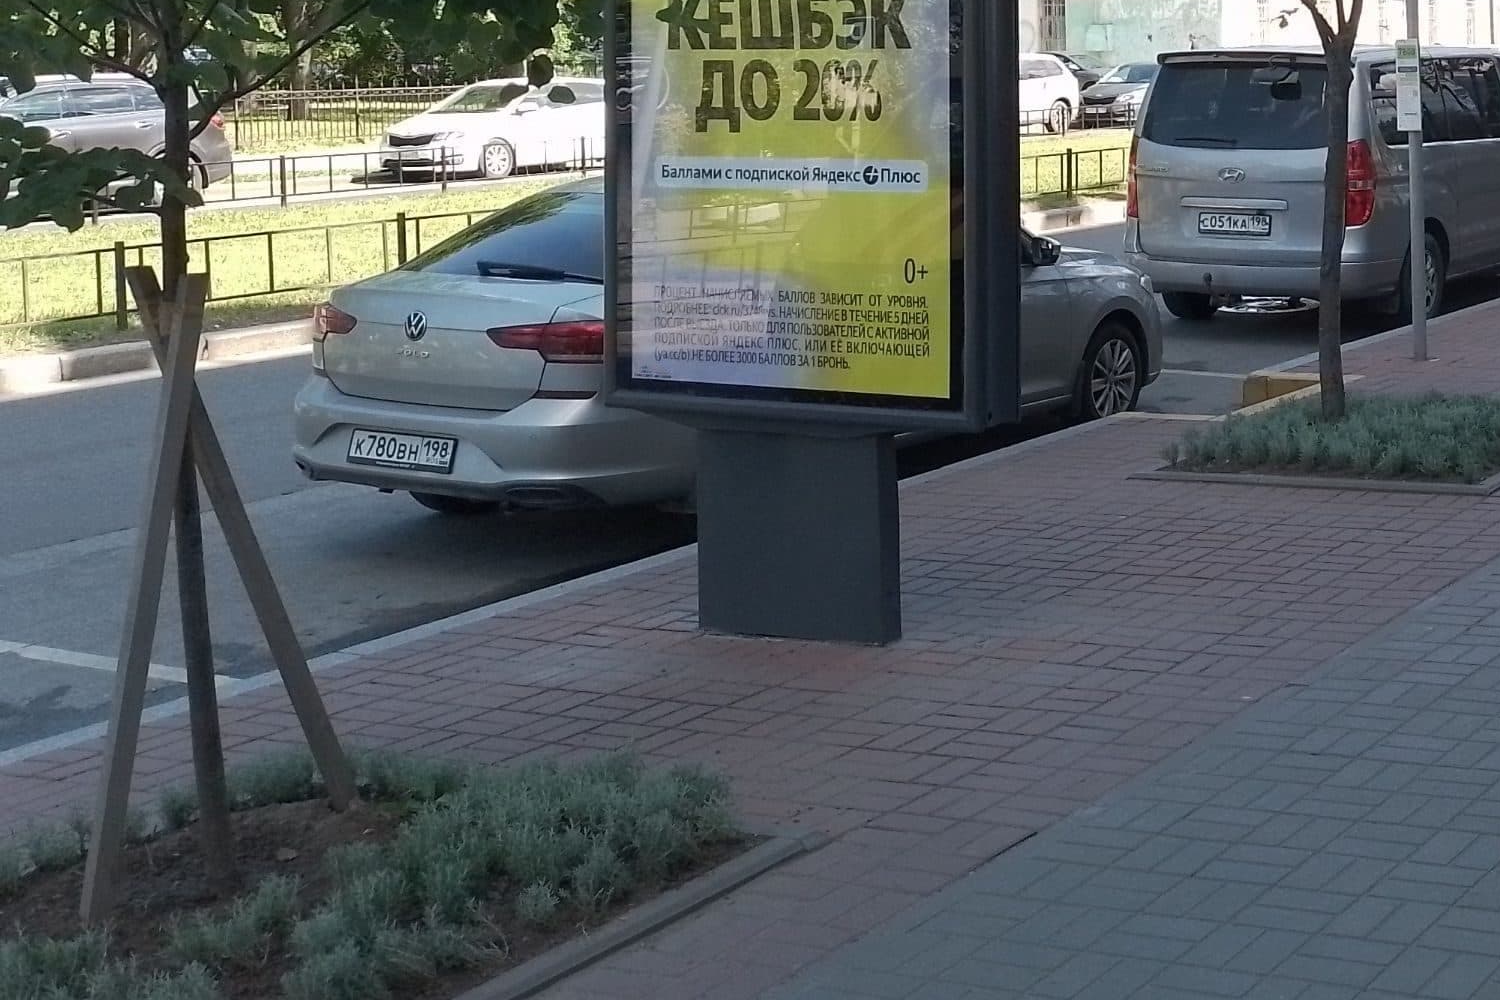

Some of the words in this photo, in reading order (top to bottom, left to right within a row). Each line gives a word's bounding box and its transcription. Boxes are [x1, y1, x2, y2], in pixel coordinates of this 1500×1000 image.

[695, 59, 781, 133] ДО
[661, 164, 722, 180] Баллами
[725, 168, 732, 180] с
[735, 166, 809, 183] подпиской
[812, 167, 860, 183] Яндекс
[881, 168, 921, 183] Плюс
[904, 258, 928, 284] 0+
[778, 290, 815, 304] БАЛЛОВ
[820, 292, 863, 306] ЗАВИСИТ
[868, 294, 882, 306] ОТ
[887, 295, 928, 308] УРОВНЯ.
[779, 306, 839, 321] НАЧИСЛЕНИЕ
[841, 310, 847, 321] В
[850, 309, 893, 323] ТЕЧЕНИЕ
[894, 312, 899, 324] 5
[901, 310, 929, 325] ДНЕЙ
[729, 320, 764, 334] ТОЛЬКО
[766, 321, 786, 334] ДЛЯ
[787, 322, 866, 338] ПОЛЬЗОВАТЕЛЕЙ
[867, 326, 874, 338] С
[875, 325, 930, 341] АКТИВНОЙ
[655, 332, 719, 346] ПОДПИСКОЙ
[722, 335, 764, 349] ЯНДЕКС
[805, 340, 827, 352] ИЛИ
[846, 341, 930, 358] ВКЛЮЧАЮЩЕЙ
[692, 350, 705, 361] НЕ
[705, 350, 735, 363] БОЛЕЕ
[736, 351, 757, 364] 3000
[758, 352, 796, 366] БАЛЛОВ
[798, 354, 809, 366] ЗА
[817, 355, 851, 369] БРОНЬ.
[356, 434, 419, 462] К780ВН
[423, 439, 449, 458] 198
